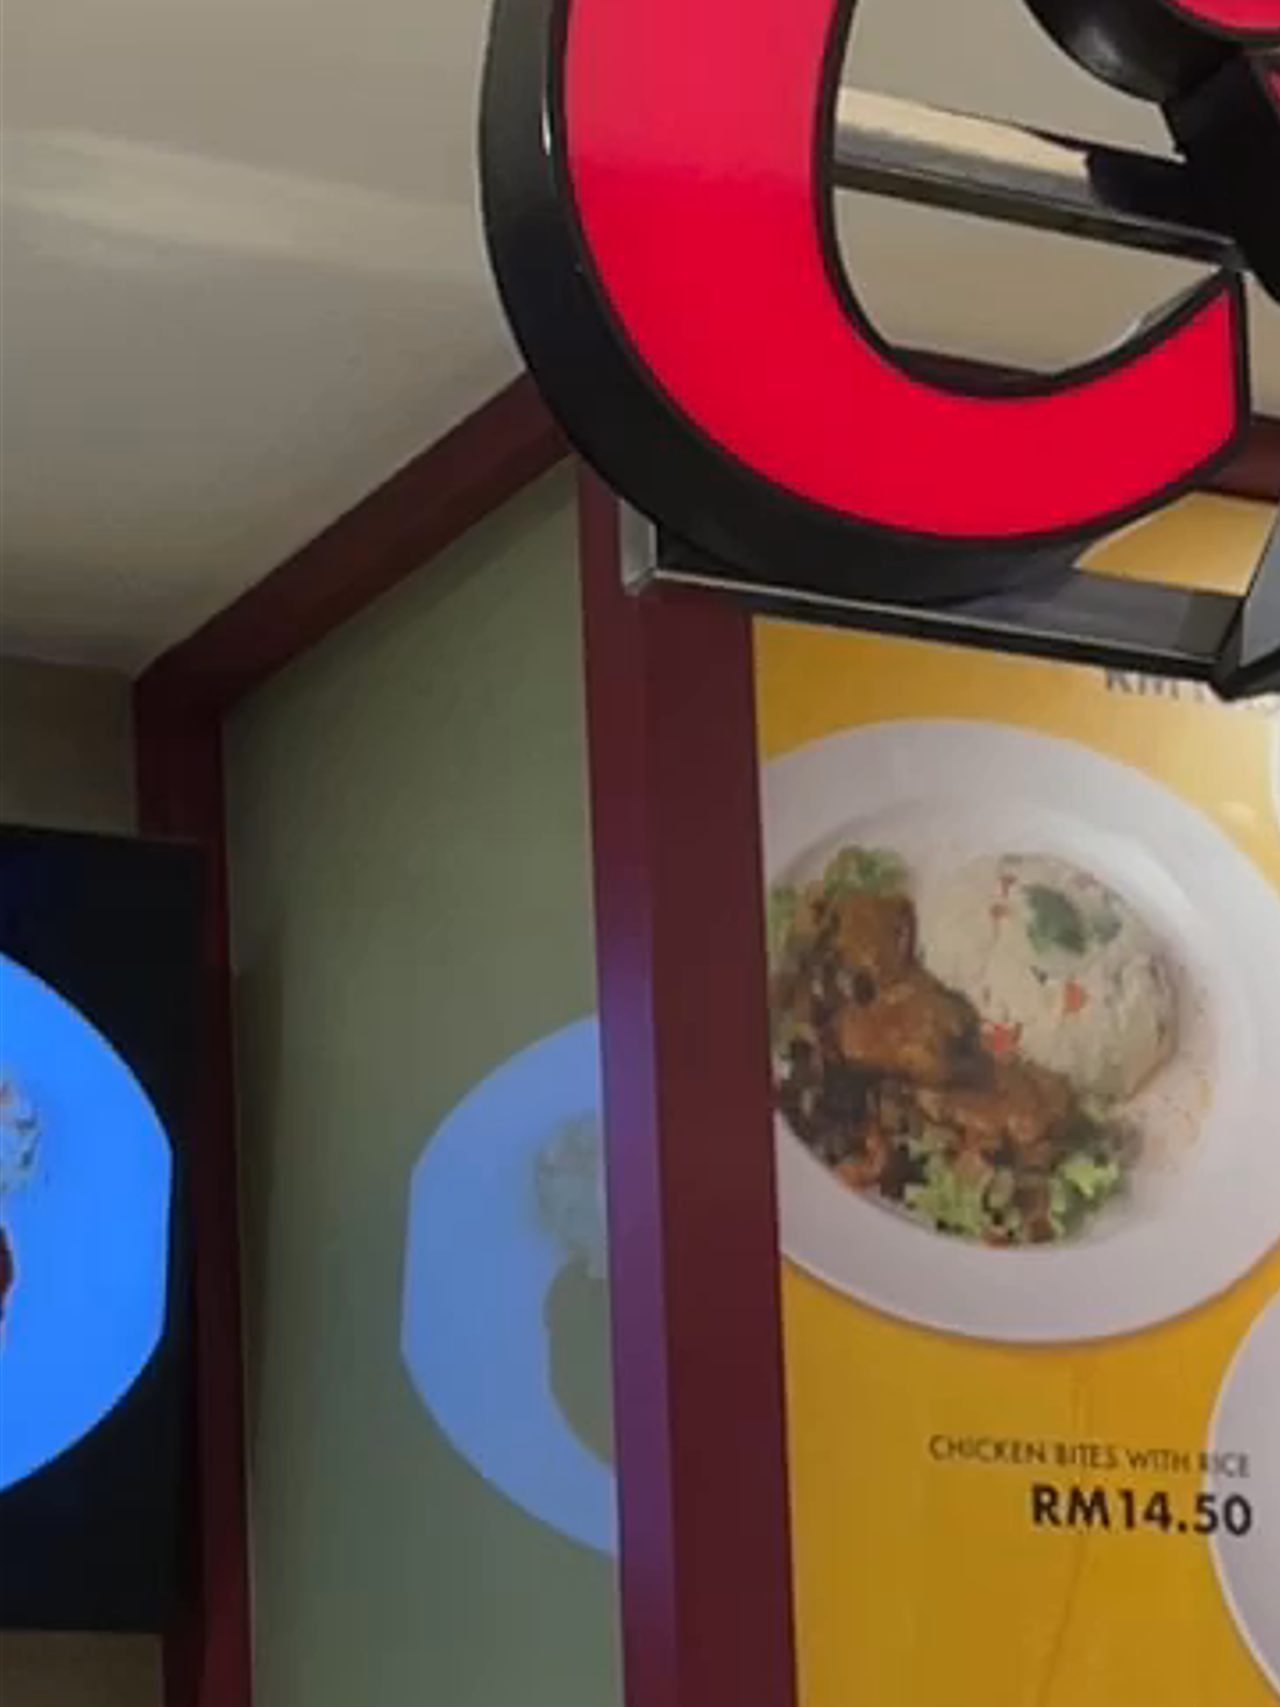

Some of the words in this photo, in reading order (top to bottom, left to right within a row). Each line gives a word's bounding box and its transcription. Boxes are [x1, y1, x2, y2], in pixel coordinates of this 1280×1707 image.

[929, 1434, 1046, 1464] CHICKEN
[1054, 1442, 1118, 1470] BITES
[1127, 1447, 1191, 1474] WITH
[1199, 1450, 1250, 1478] RICE
[1030, 1483, 1253, 1536] RM14.50
